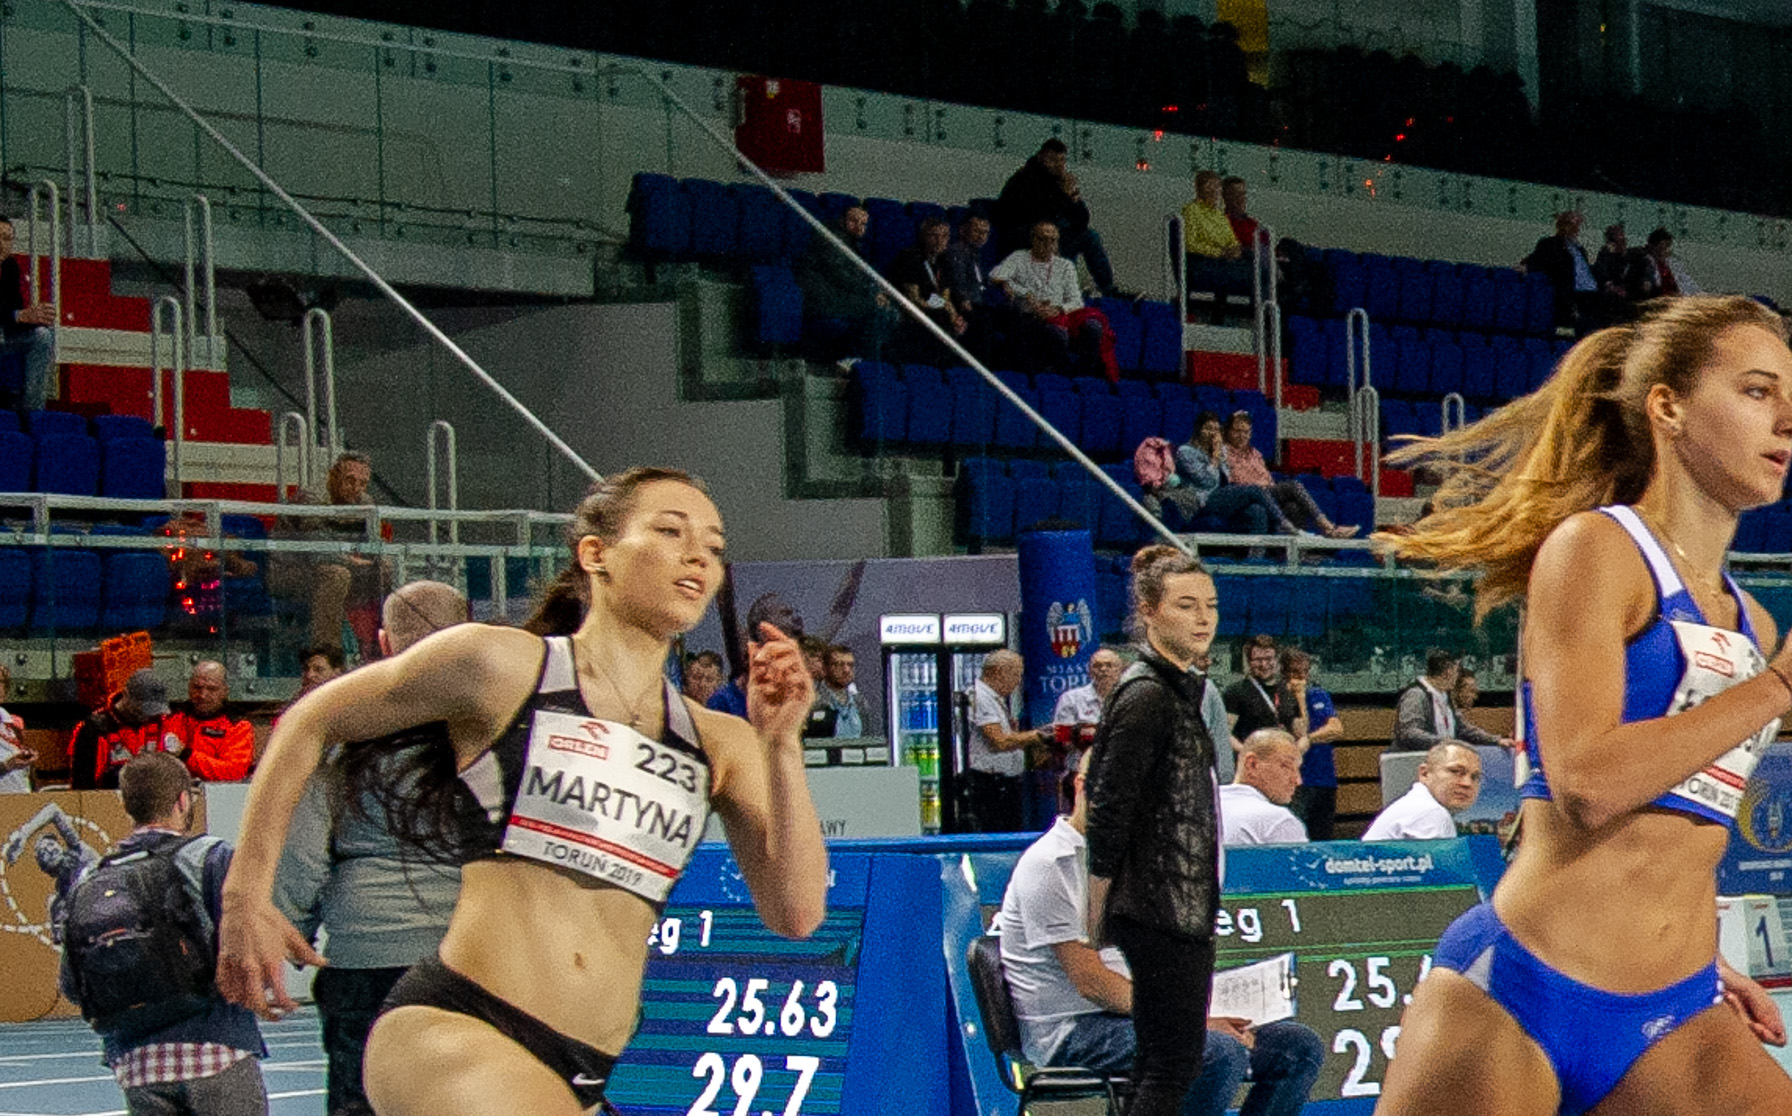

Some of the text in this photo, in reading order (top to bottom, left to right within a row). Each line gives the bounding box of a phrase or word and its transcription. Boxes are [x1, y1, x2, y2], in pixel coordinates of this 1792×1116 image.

[635, 743, 696, 793] 223
[526, 766, 693, 848] MARTYNA
[544, 841, 607, 873] TORUŃ
[608, 863, 643, 884] 2019
[699, 910, 713, 947] 1
[1281, 899, 1301, 933] 1
[1756, 916, 1775, 968] 1
[707, 978, 838, 1038] 25.63
